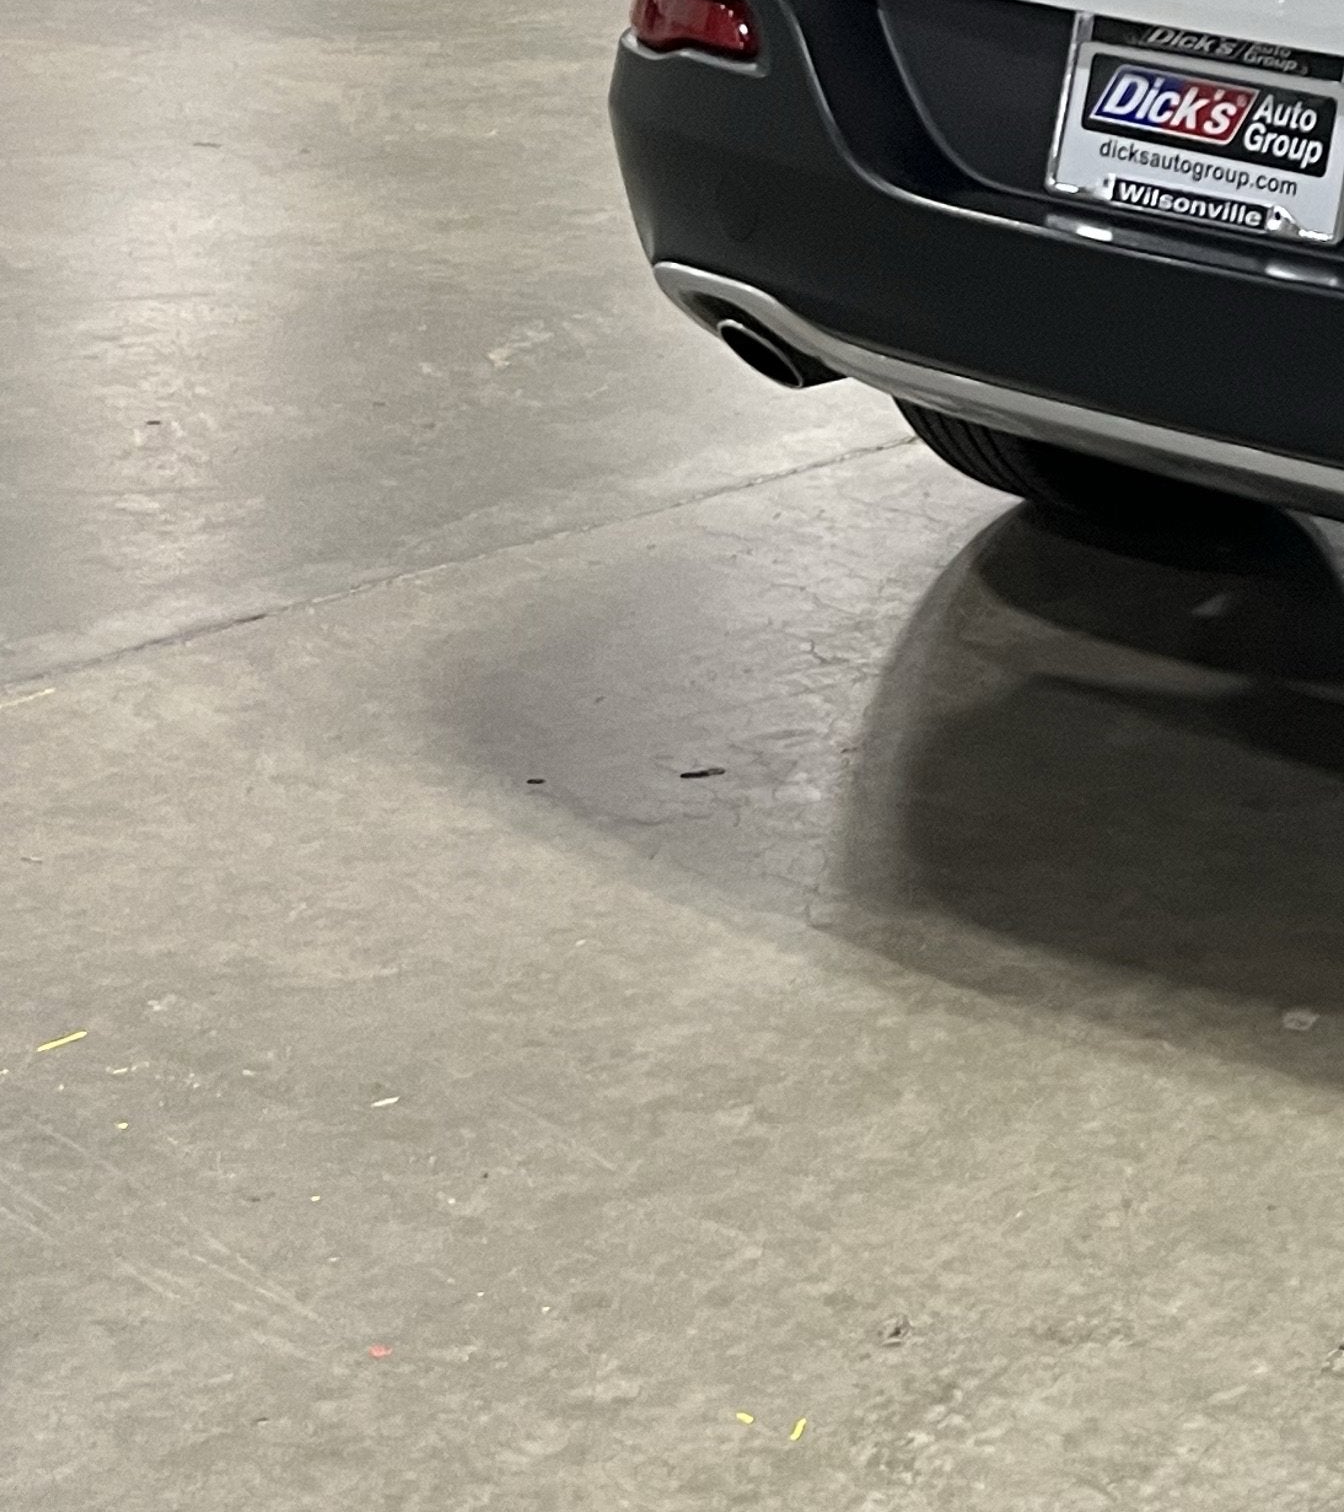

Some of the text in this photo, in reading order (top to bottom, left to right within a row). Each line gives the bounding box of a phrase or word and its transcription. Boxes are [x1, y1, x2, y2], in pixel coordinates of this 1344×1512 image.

[1243, 51, 1299, 72] Group
[1252, 94, 1318, 132] Auto
[1098, 139, 1298, 198] dicksautogroup.com
[1243, 123, 1323, 169] Group
[1118, 181, 1263, 227] Wilsonville
